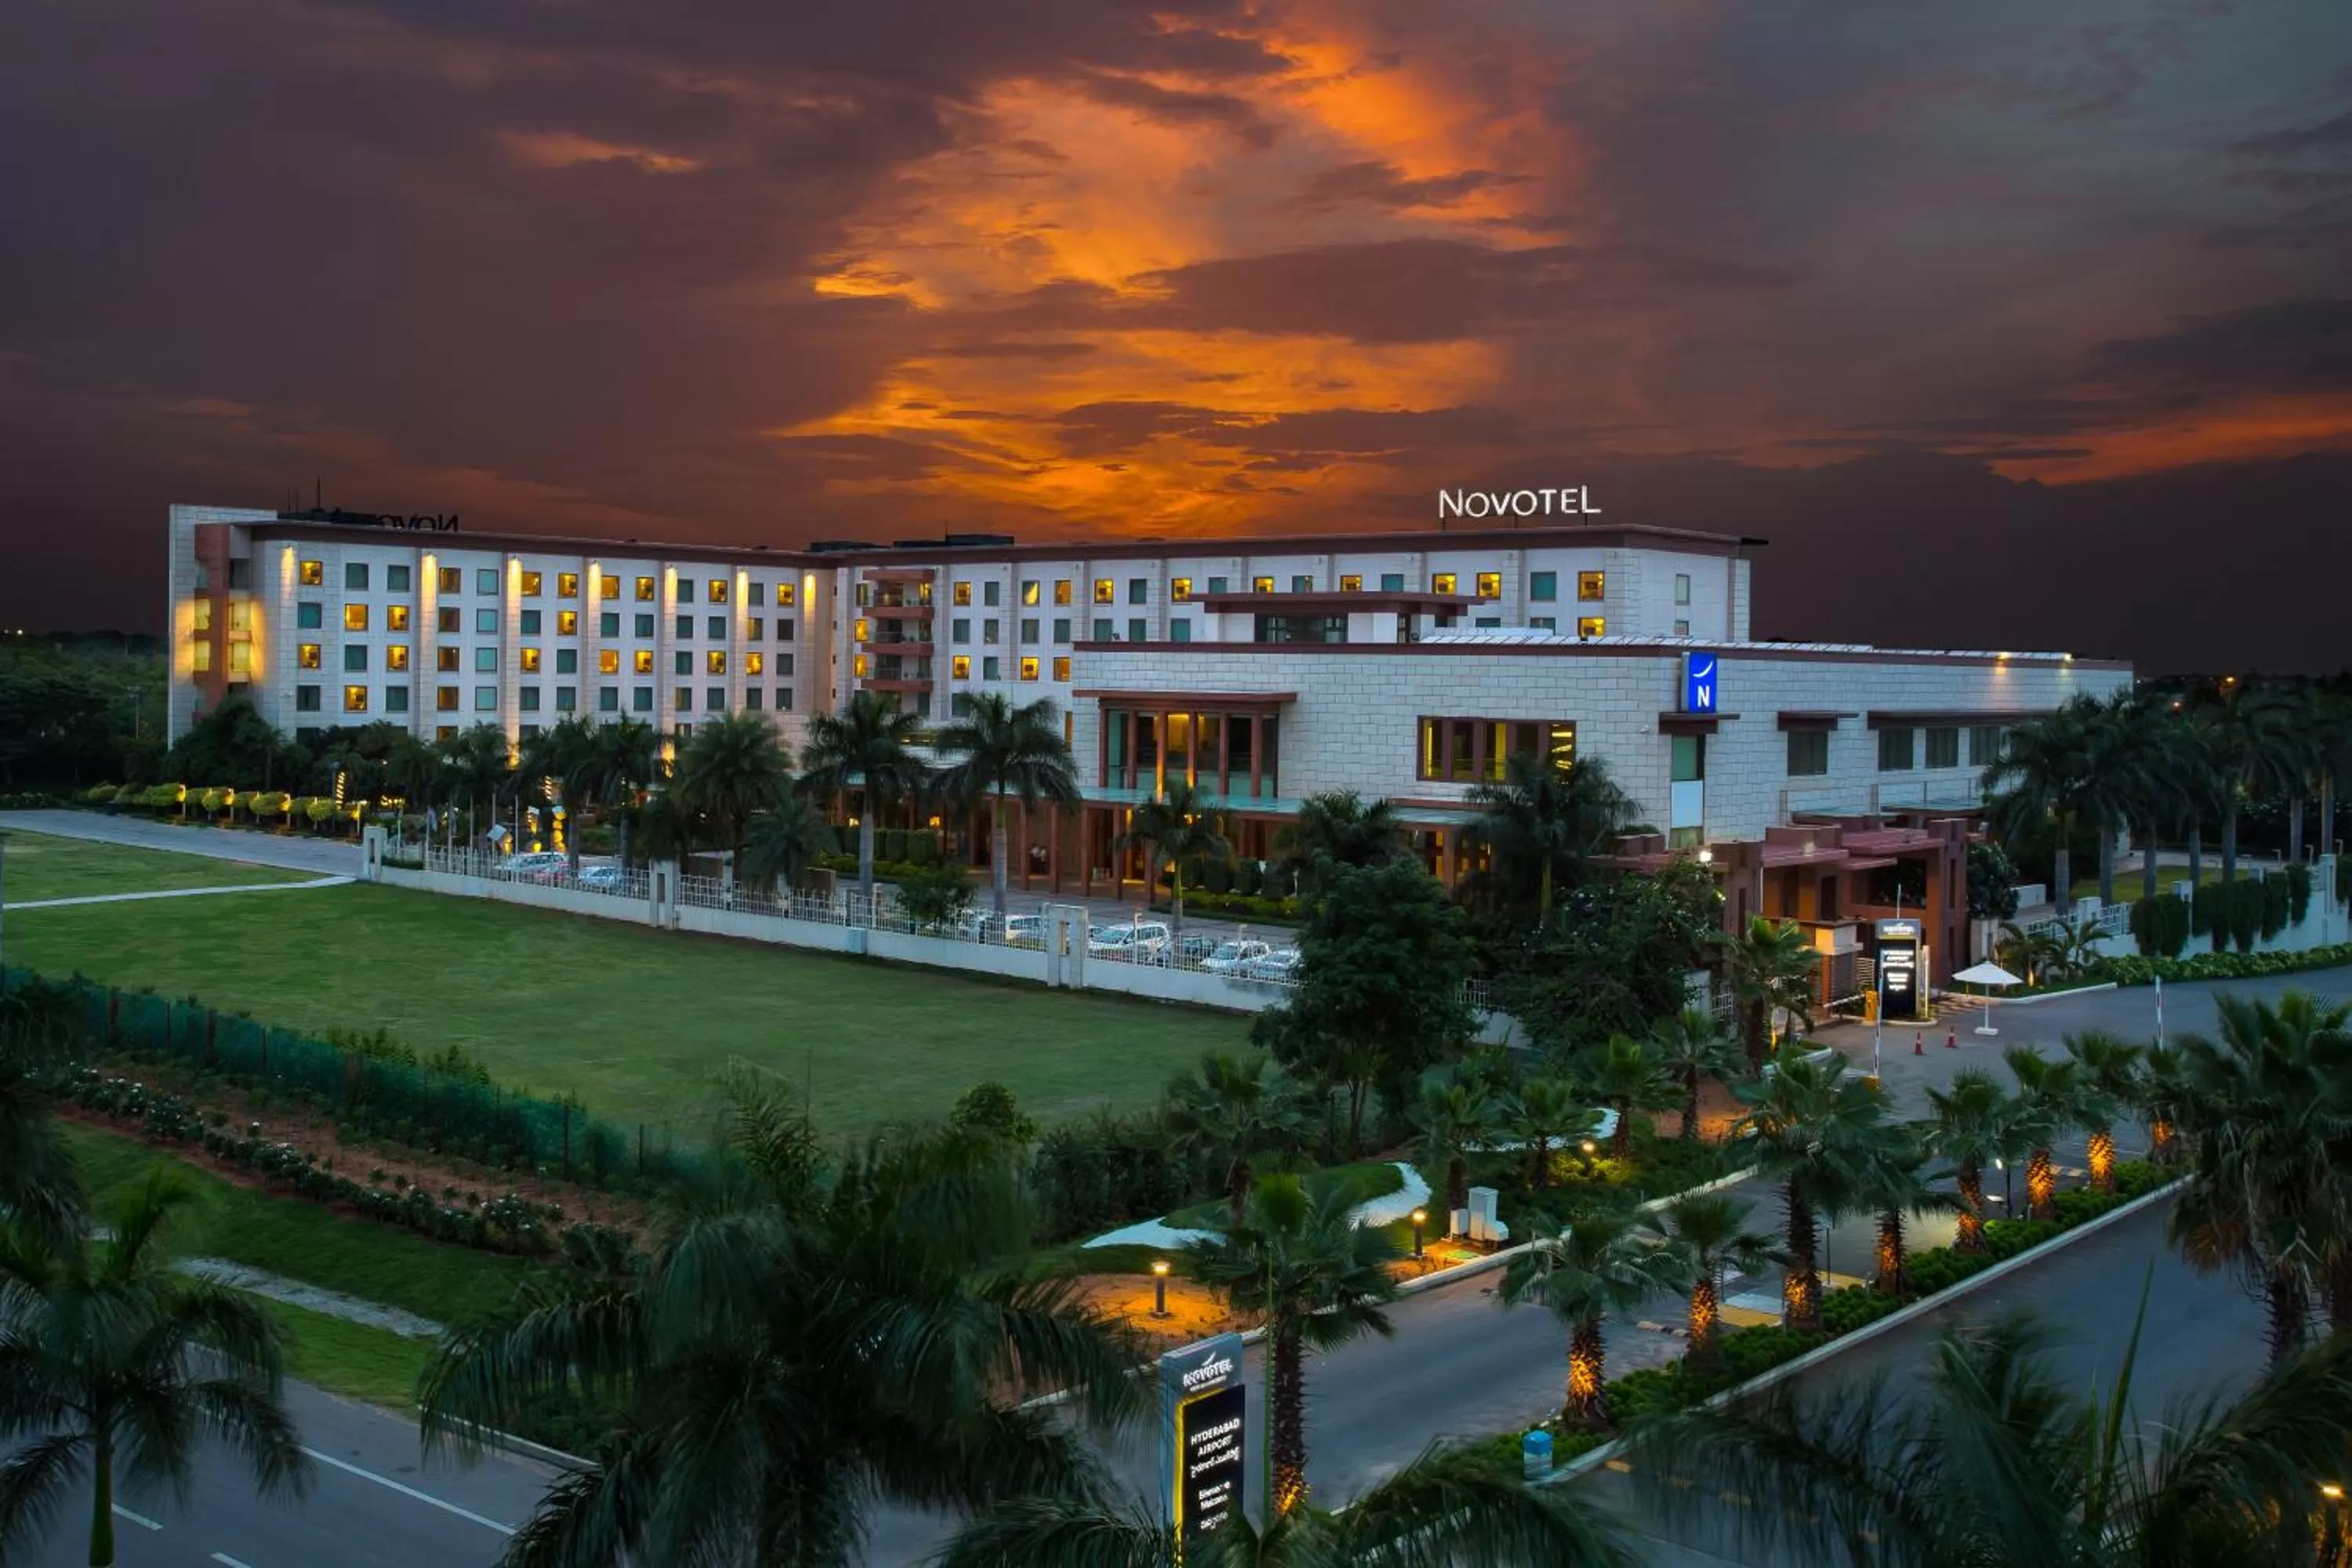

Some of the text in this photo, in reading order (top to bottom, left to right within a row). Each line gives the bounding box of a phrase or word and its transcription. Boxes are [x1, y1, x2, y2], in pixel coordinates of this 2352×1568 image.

[1439, 485, 1602, 518] NOVOTEL
[1697, 684, 1710, 707] N
[1183, 1357, 1234, 1386] NOVOTEL
[1190, 1417, 1240, 1446] HYDERABAD
[1197, 1435, 1232, 1457] AIRPORT
